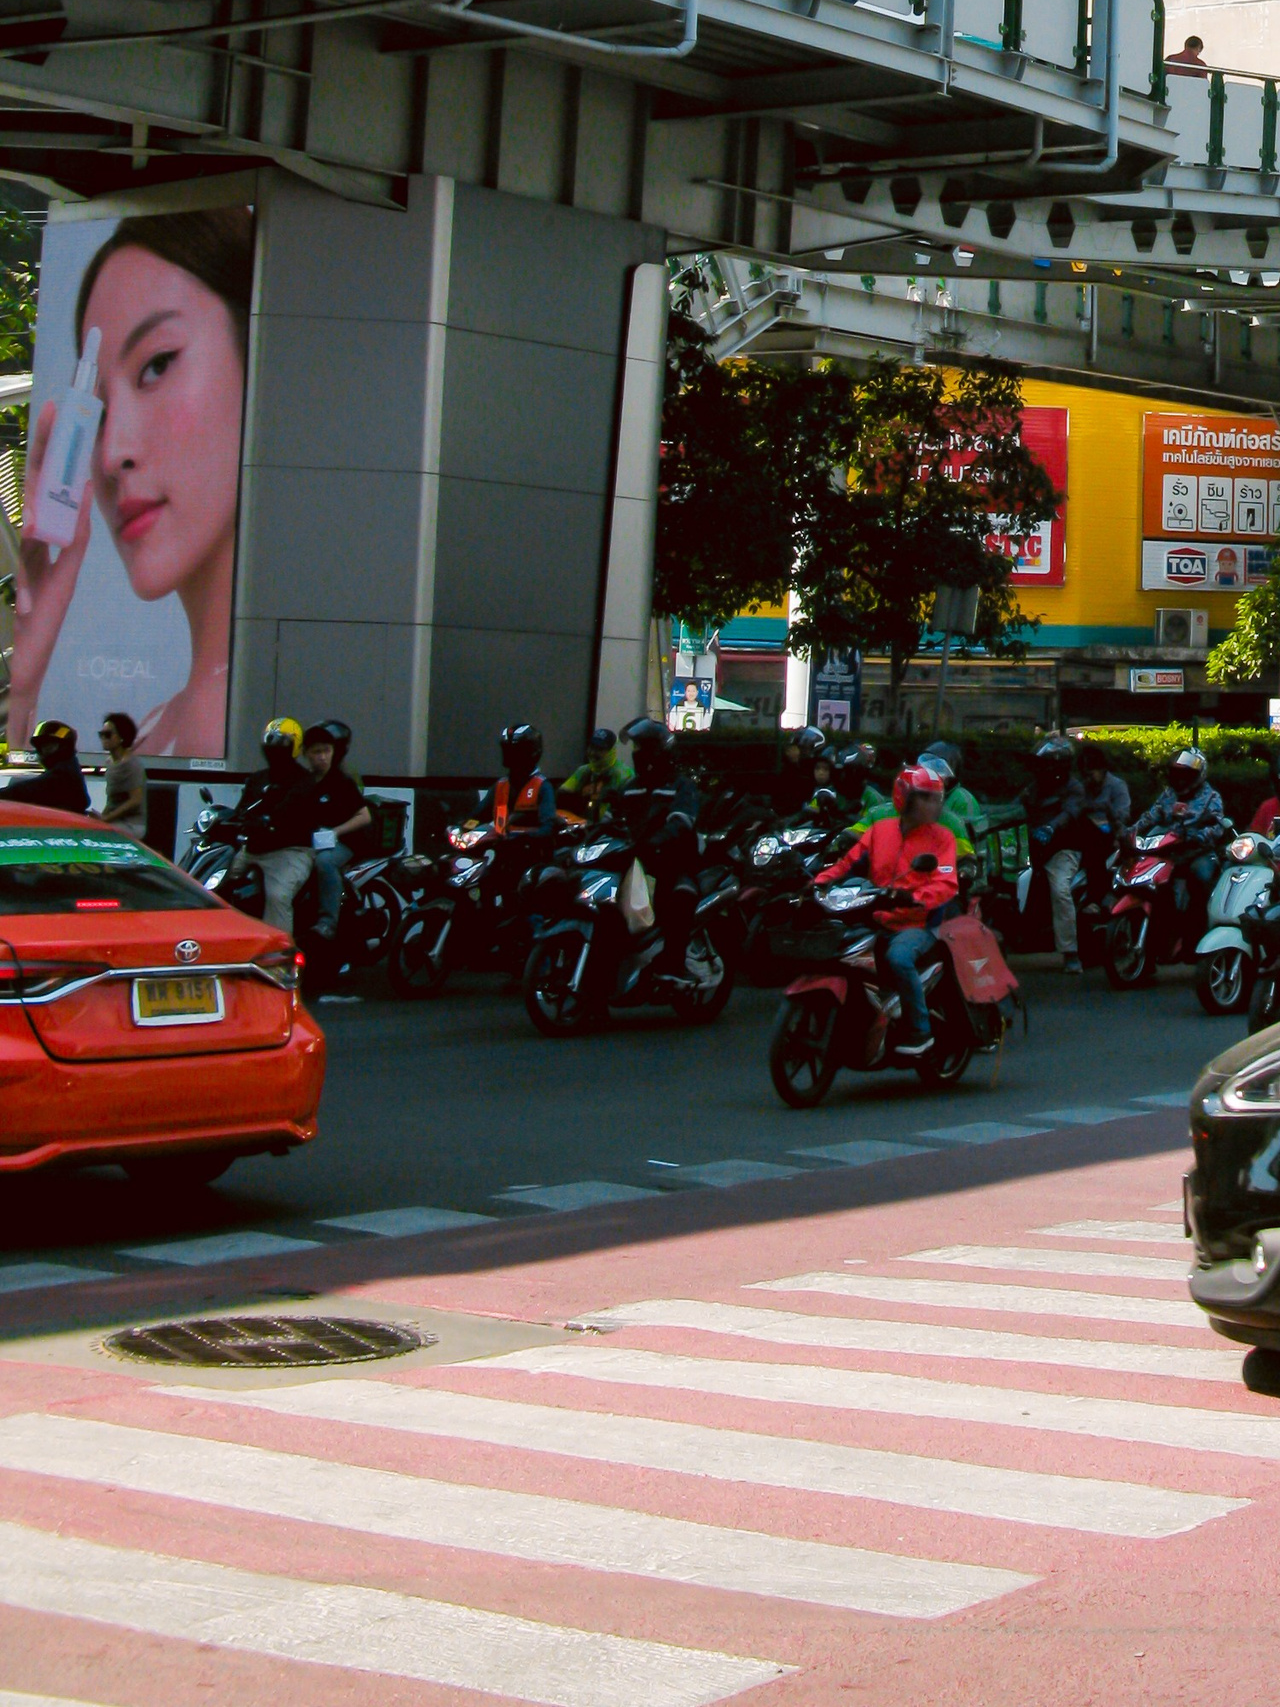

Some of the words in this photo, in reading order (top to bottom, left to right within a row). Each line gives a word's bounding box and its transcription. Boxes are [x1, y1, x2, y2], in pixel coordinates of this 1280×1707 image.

[1172, 478, 1188, 496] รั่ว
[1240, 484, 1262, 499] ร้าว
[1169, 558, 1204, 574] TOA
